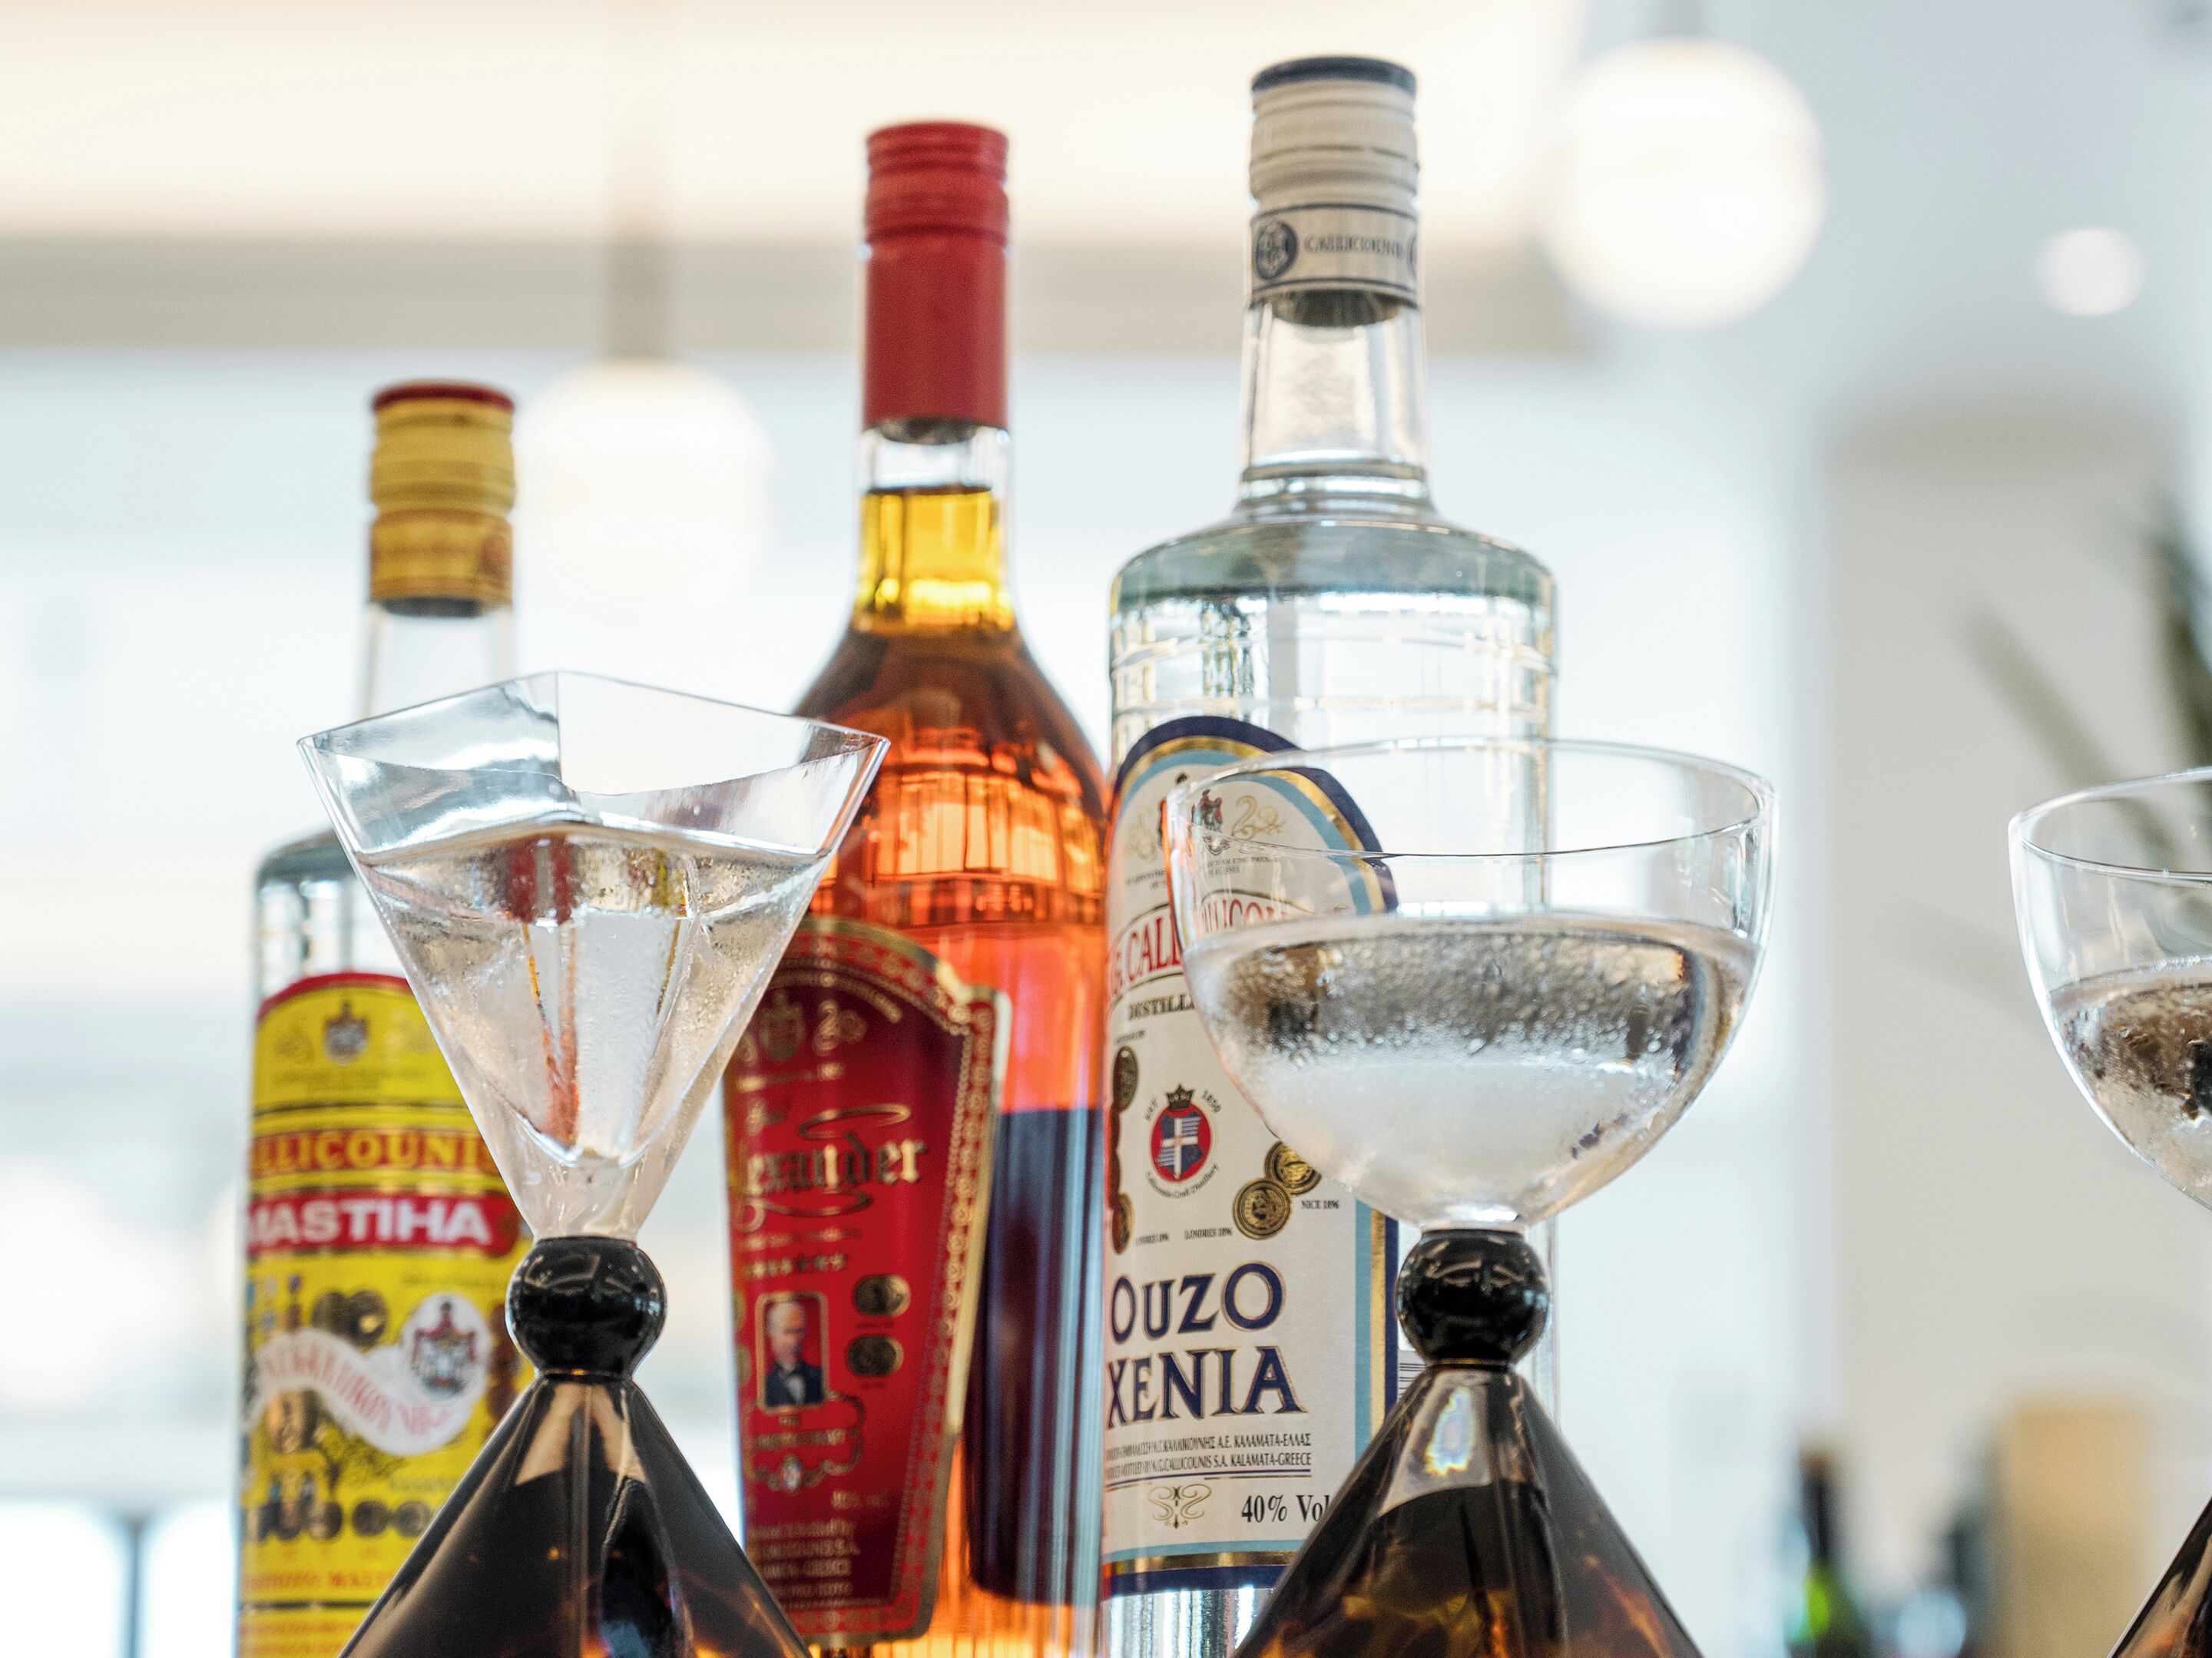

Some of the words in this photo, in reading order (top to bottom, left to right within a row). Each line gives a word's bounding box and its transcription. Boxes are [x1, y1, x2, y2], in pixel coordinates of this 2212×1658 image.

[1111, 1259, 1288, 1345] OUZO
[1108, 1345, 1309, 1430] XENIA
[1241, 1494, 1288, 1524] 40%
